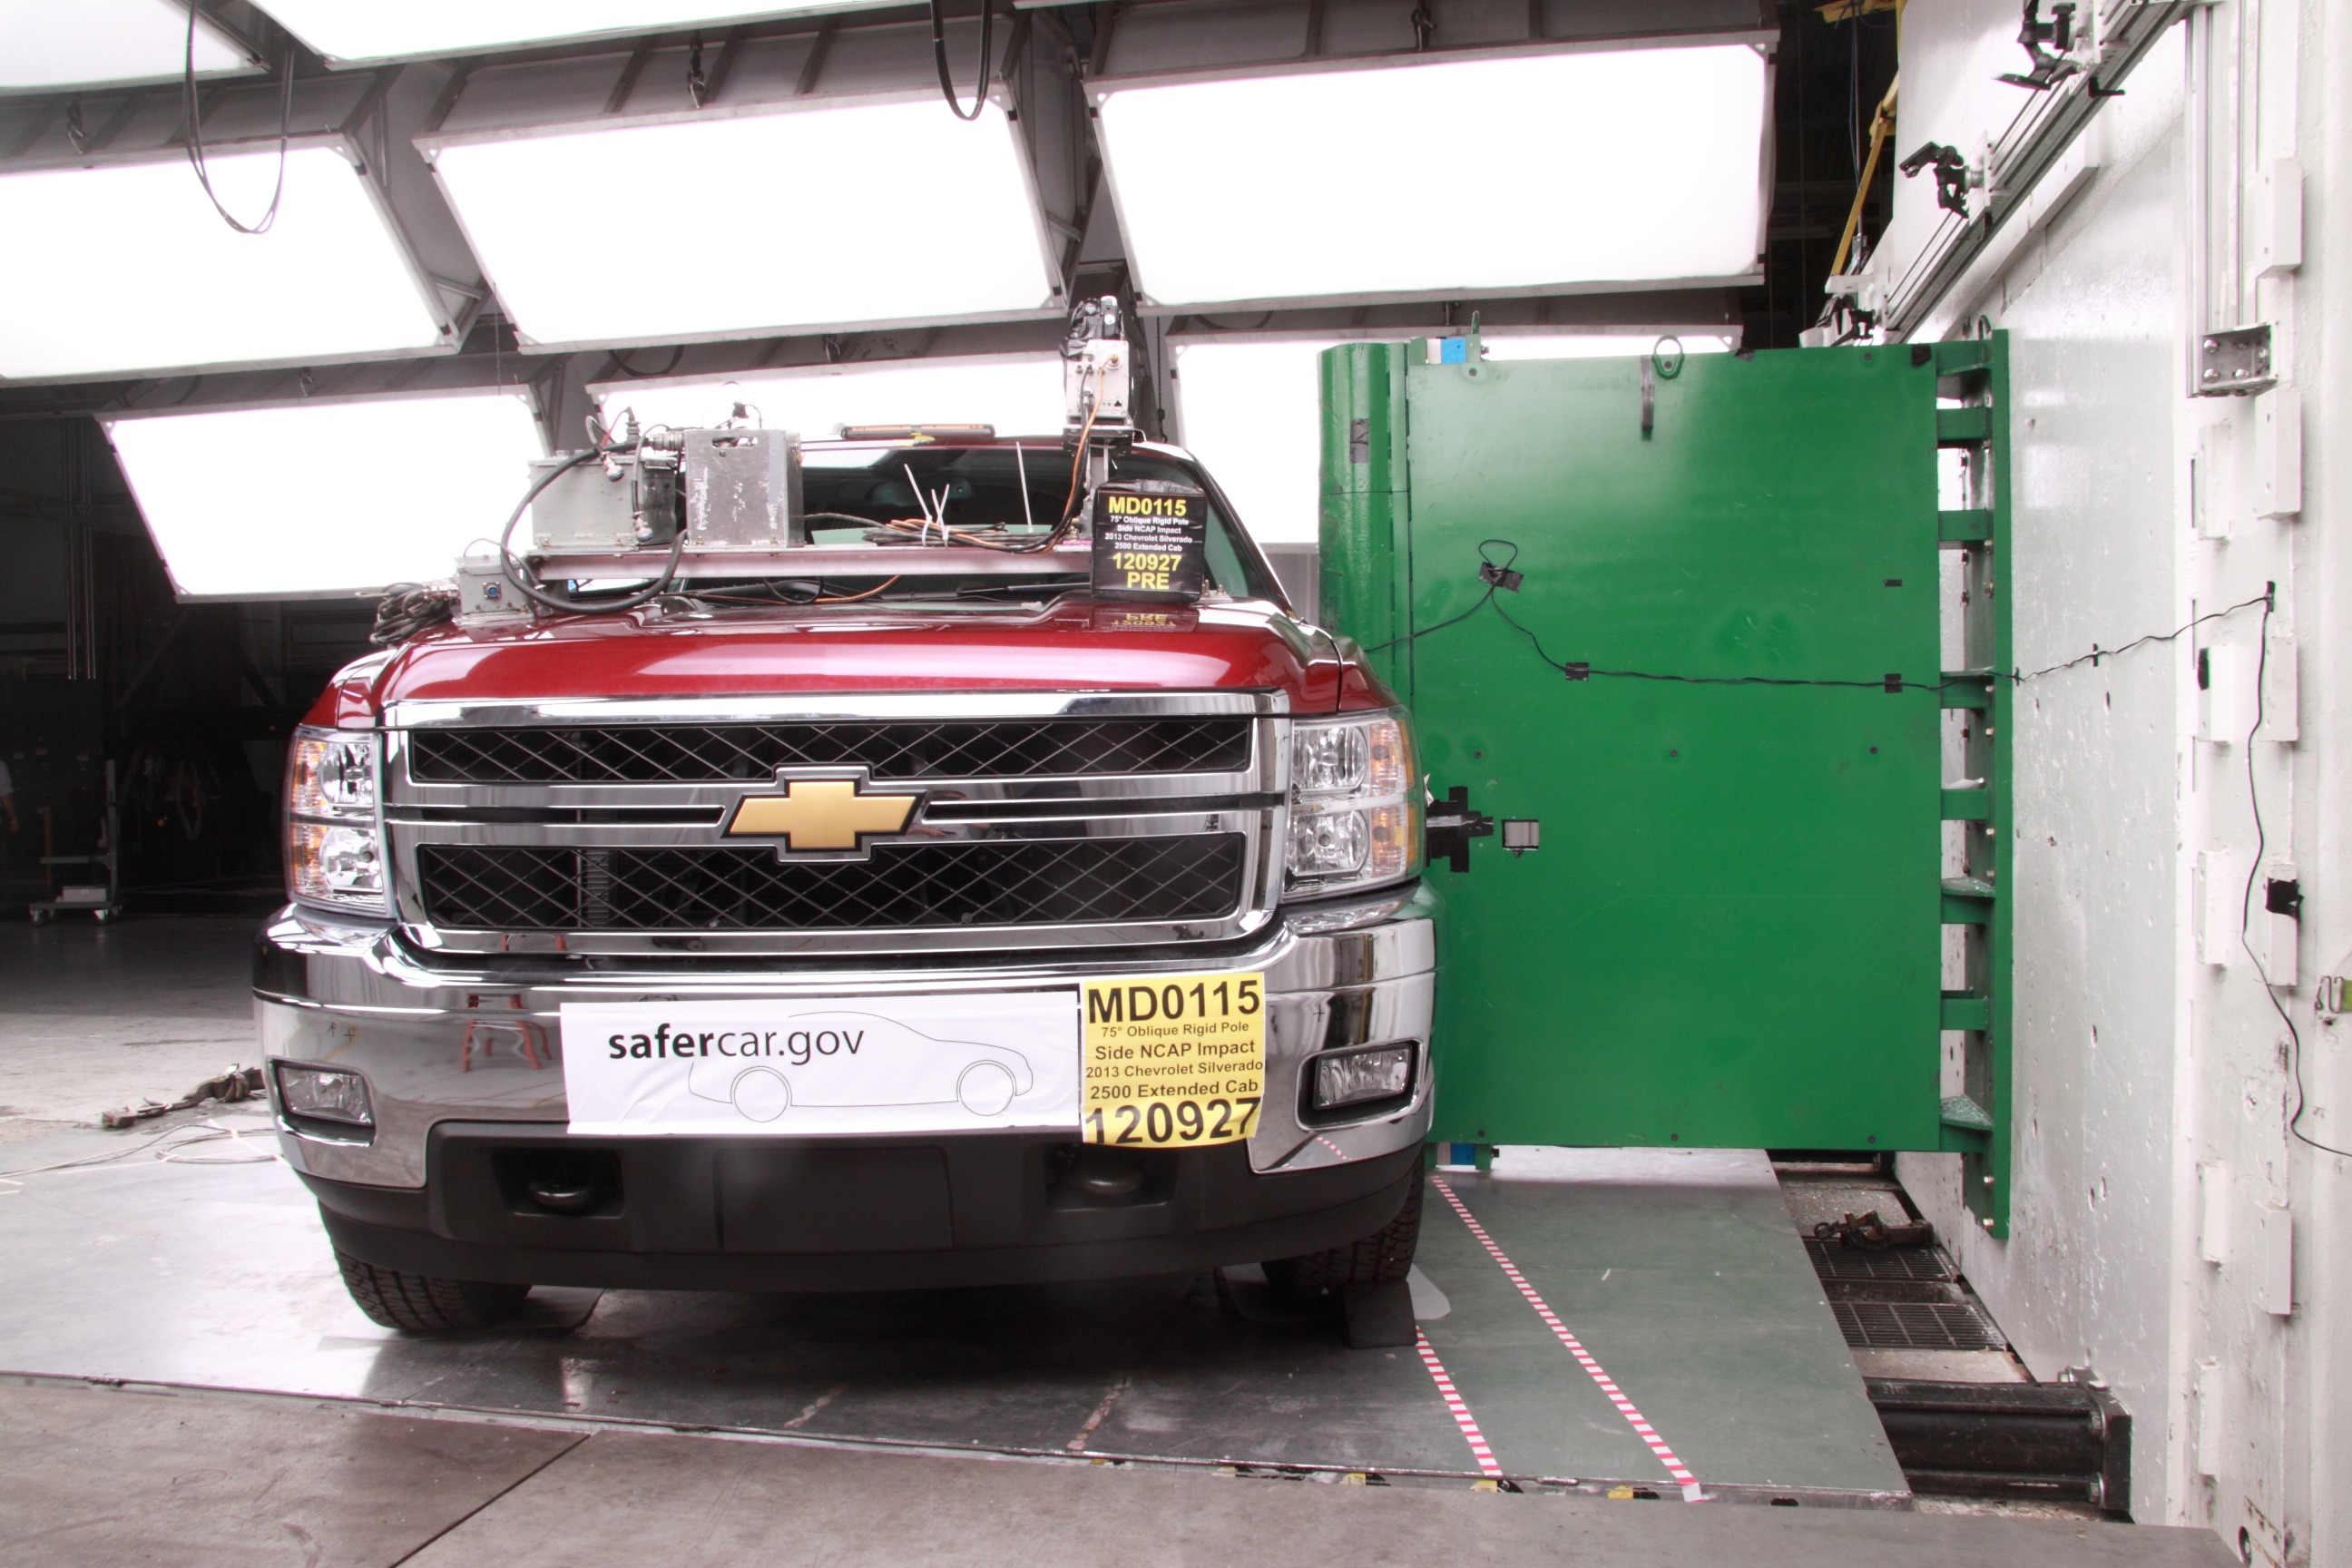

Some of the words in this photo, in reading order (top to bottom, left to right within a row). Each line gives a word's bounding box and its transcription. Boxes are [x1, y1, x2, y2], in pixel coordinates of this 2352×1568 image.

[1109, 496, 1187, 516] MD0115
[1117, 524, 1132, 533] Side
[1158, 526, 1181, 534] Impact
[1123, 516, 1151, 524] Oblique
[1152, 517, 1171, 525] Rigid
[1105, 533, 1122, 541] 2013
[1123, 534, 1158, 542] Chevrolet
[1159, 534, 1192, 544] Silverado
[1114, 542, 1132, 550] 2500
[1133, 543, 1166, 551] Extended
[1168, 544, 1182, 552] Cab
[1112, 553, 1182, 572] 120927
[1127, 572, 1170, 589] PRE
[1088, 979, 1260, 1024] MD0115
[1127, 1025, 1179, 1038] Oblique
[1183, 1023, 1217, 1036] Rigid
[1221, 1022, 1250, 1033] Pole
[608, 1023, 865, 1065] safercar.gov
[1095, 1046, 1134, 1060] Side
[1141, 1044, 1191, 1058] NCAP
[1198, 1040, 1256, 1058] Impact
[1086, 1066, 1120, 1078] 2013
[1124, 1063, 1193, 1077] Chevrolet
[1198, 1060, 1263, 1073] Silverado
[1091, 1085, 1132, 1099] 2500
[1138, 1081, 1220, 1098] Extended
[1226, 1079, 1259, 1093] Cab
[1085, 1096, 1261, 1144] 120927
